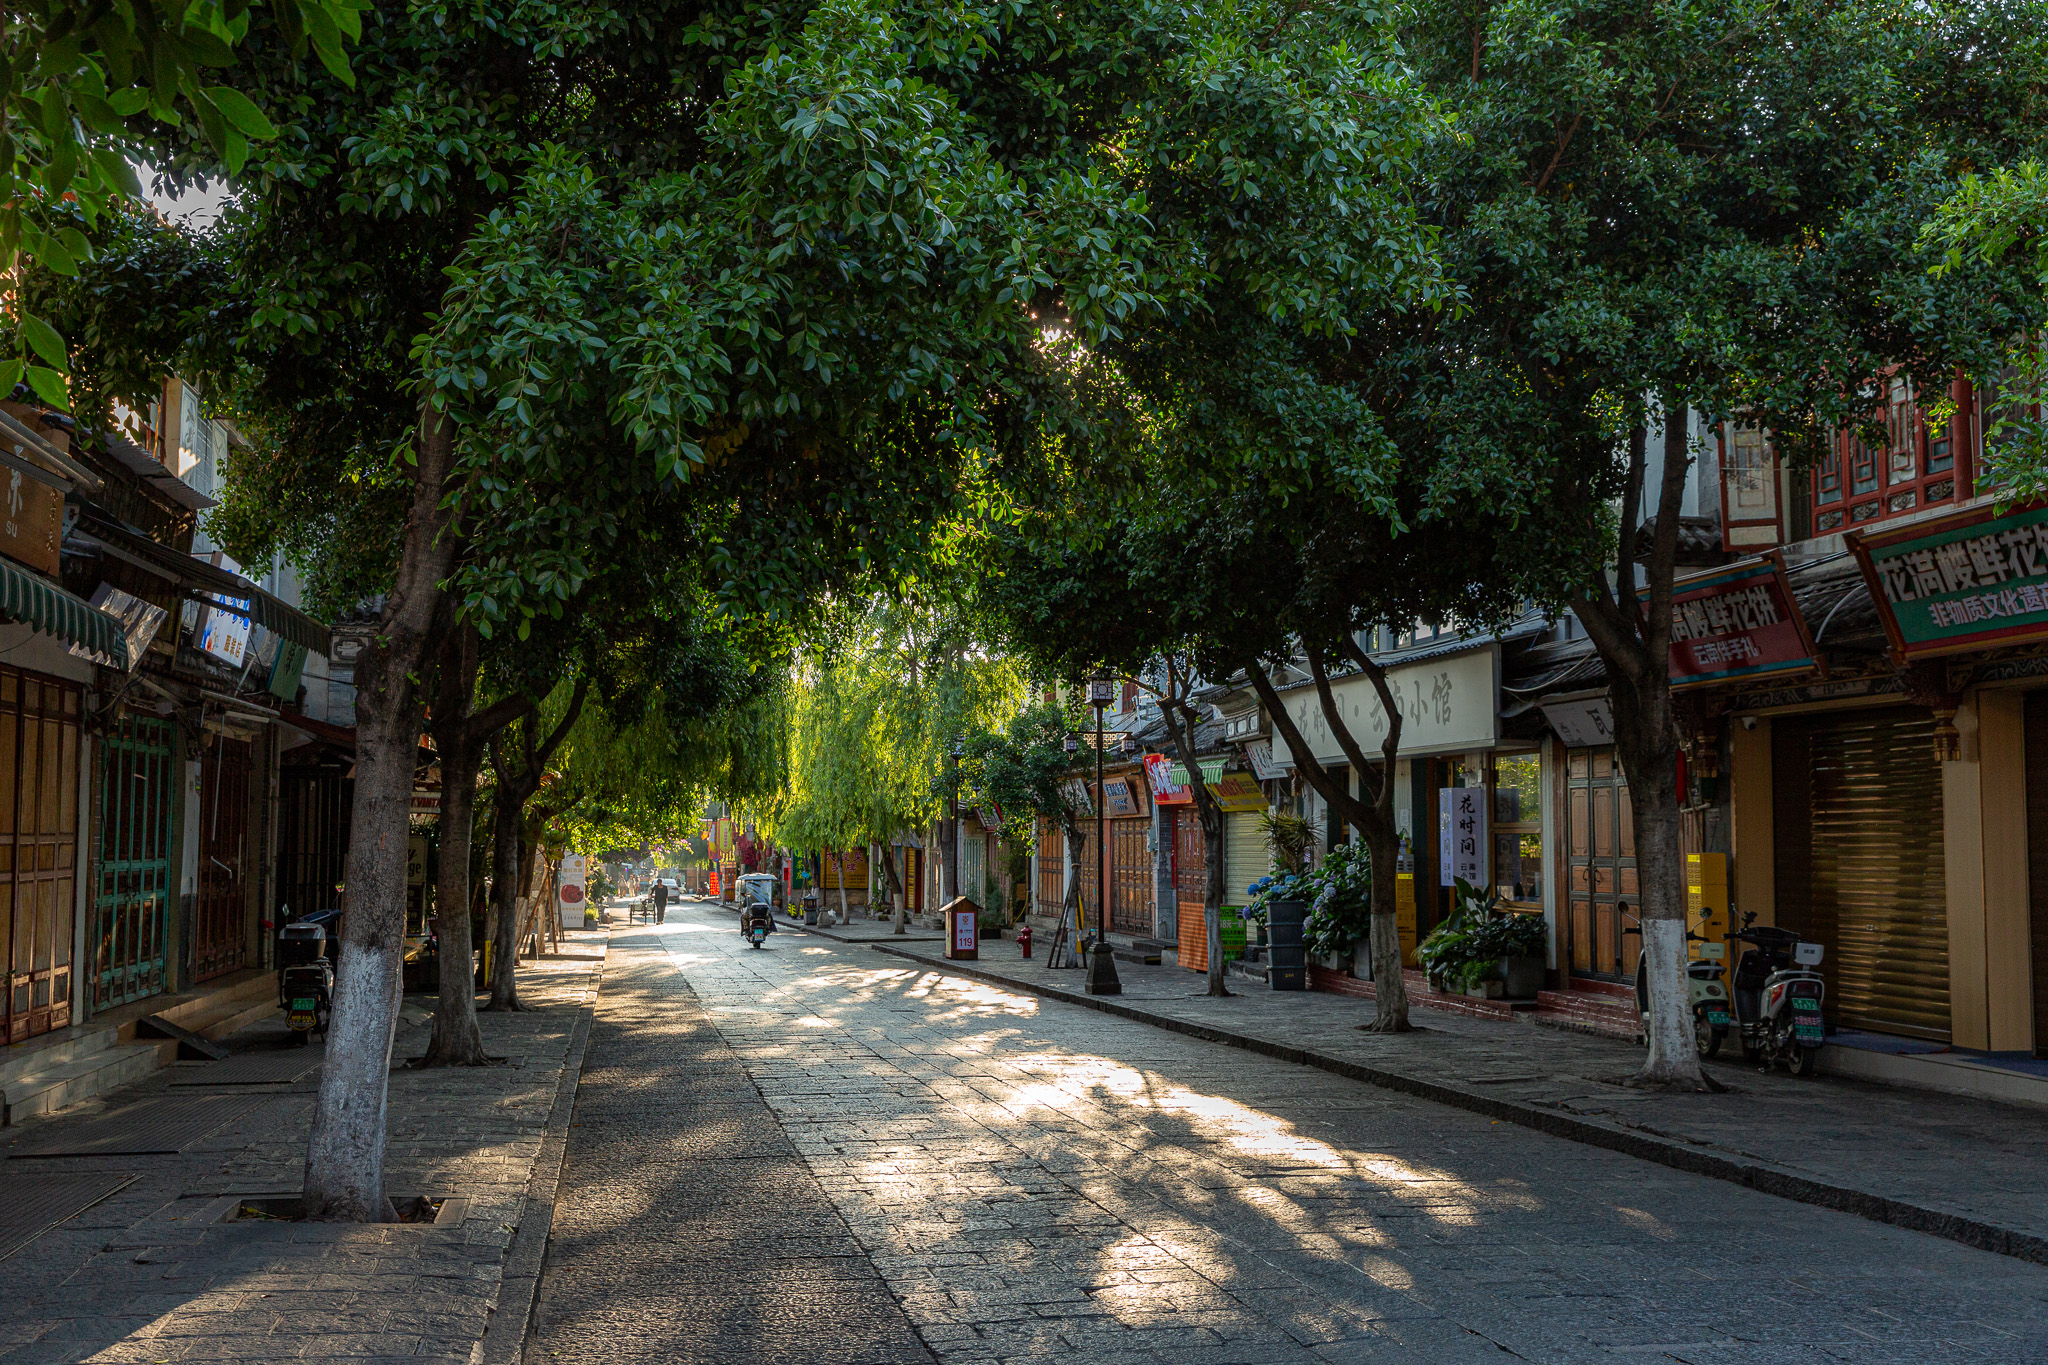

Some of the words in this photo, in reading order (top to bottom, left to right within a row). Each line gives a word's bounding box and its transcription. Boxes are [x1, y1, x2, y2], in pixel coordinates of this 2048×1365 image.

[1669, 585, 1779, 644] 满楼鲜花饼
[1692, 636, 1761, 666] 云南伴手礼
[1459, 793, 1476, 856] 花时间
[959, 937, 973, 947] 119
